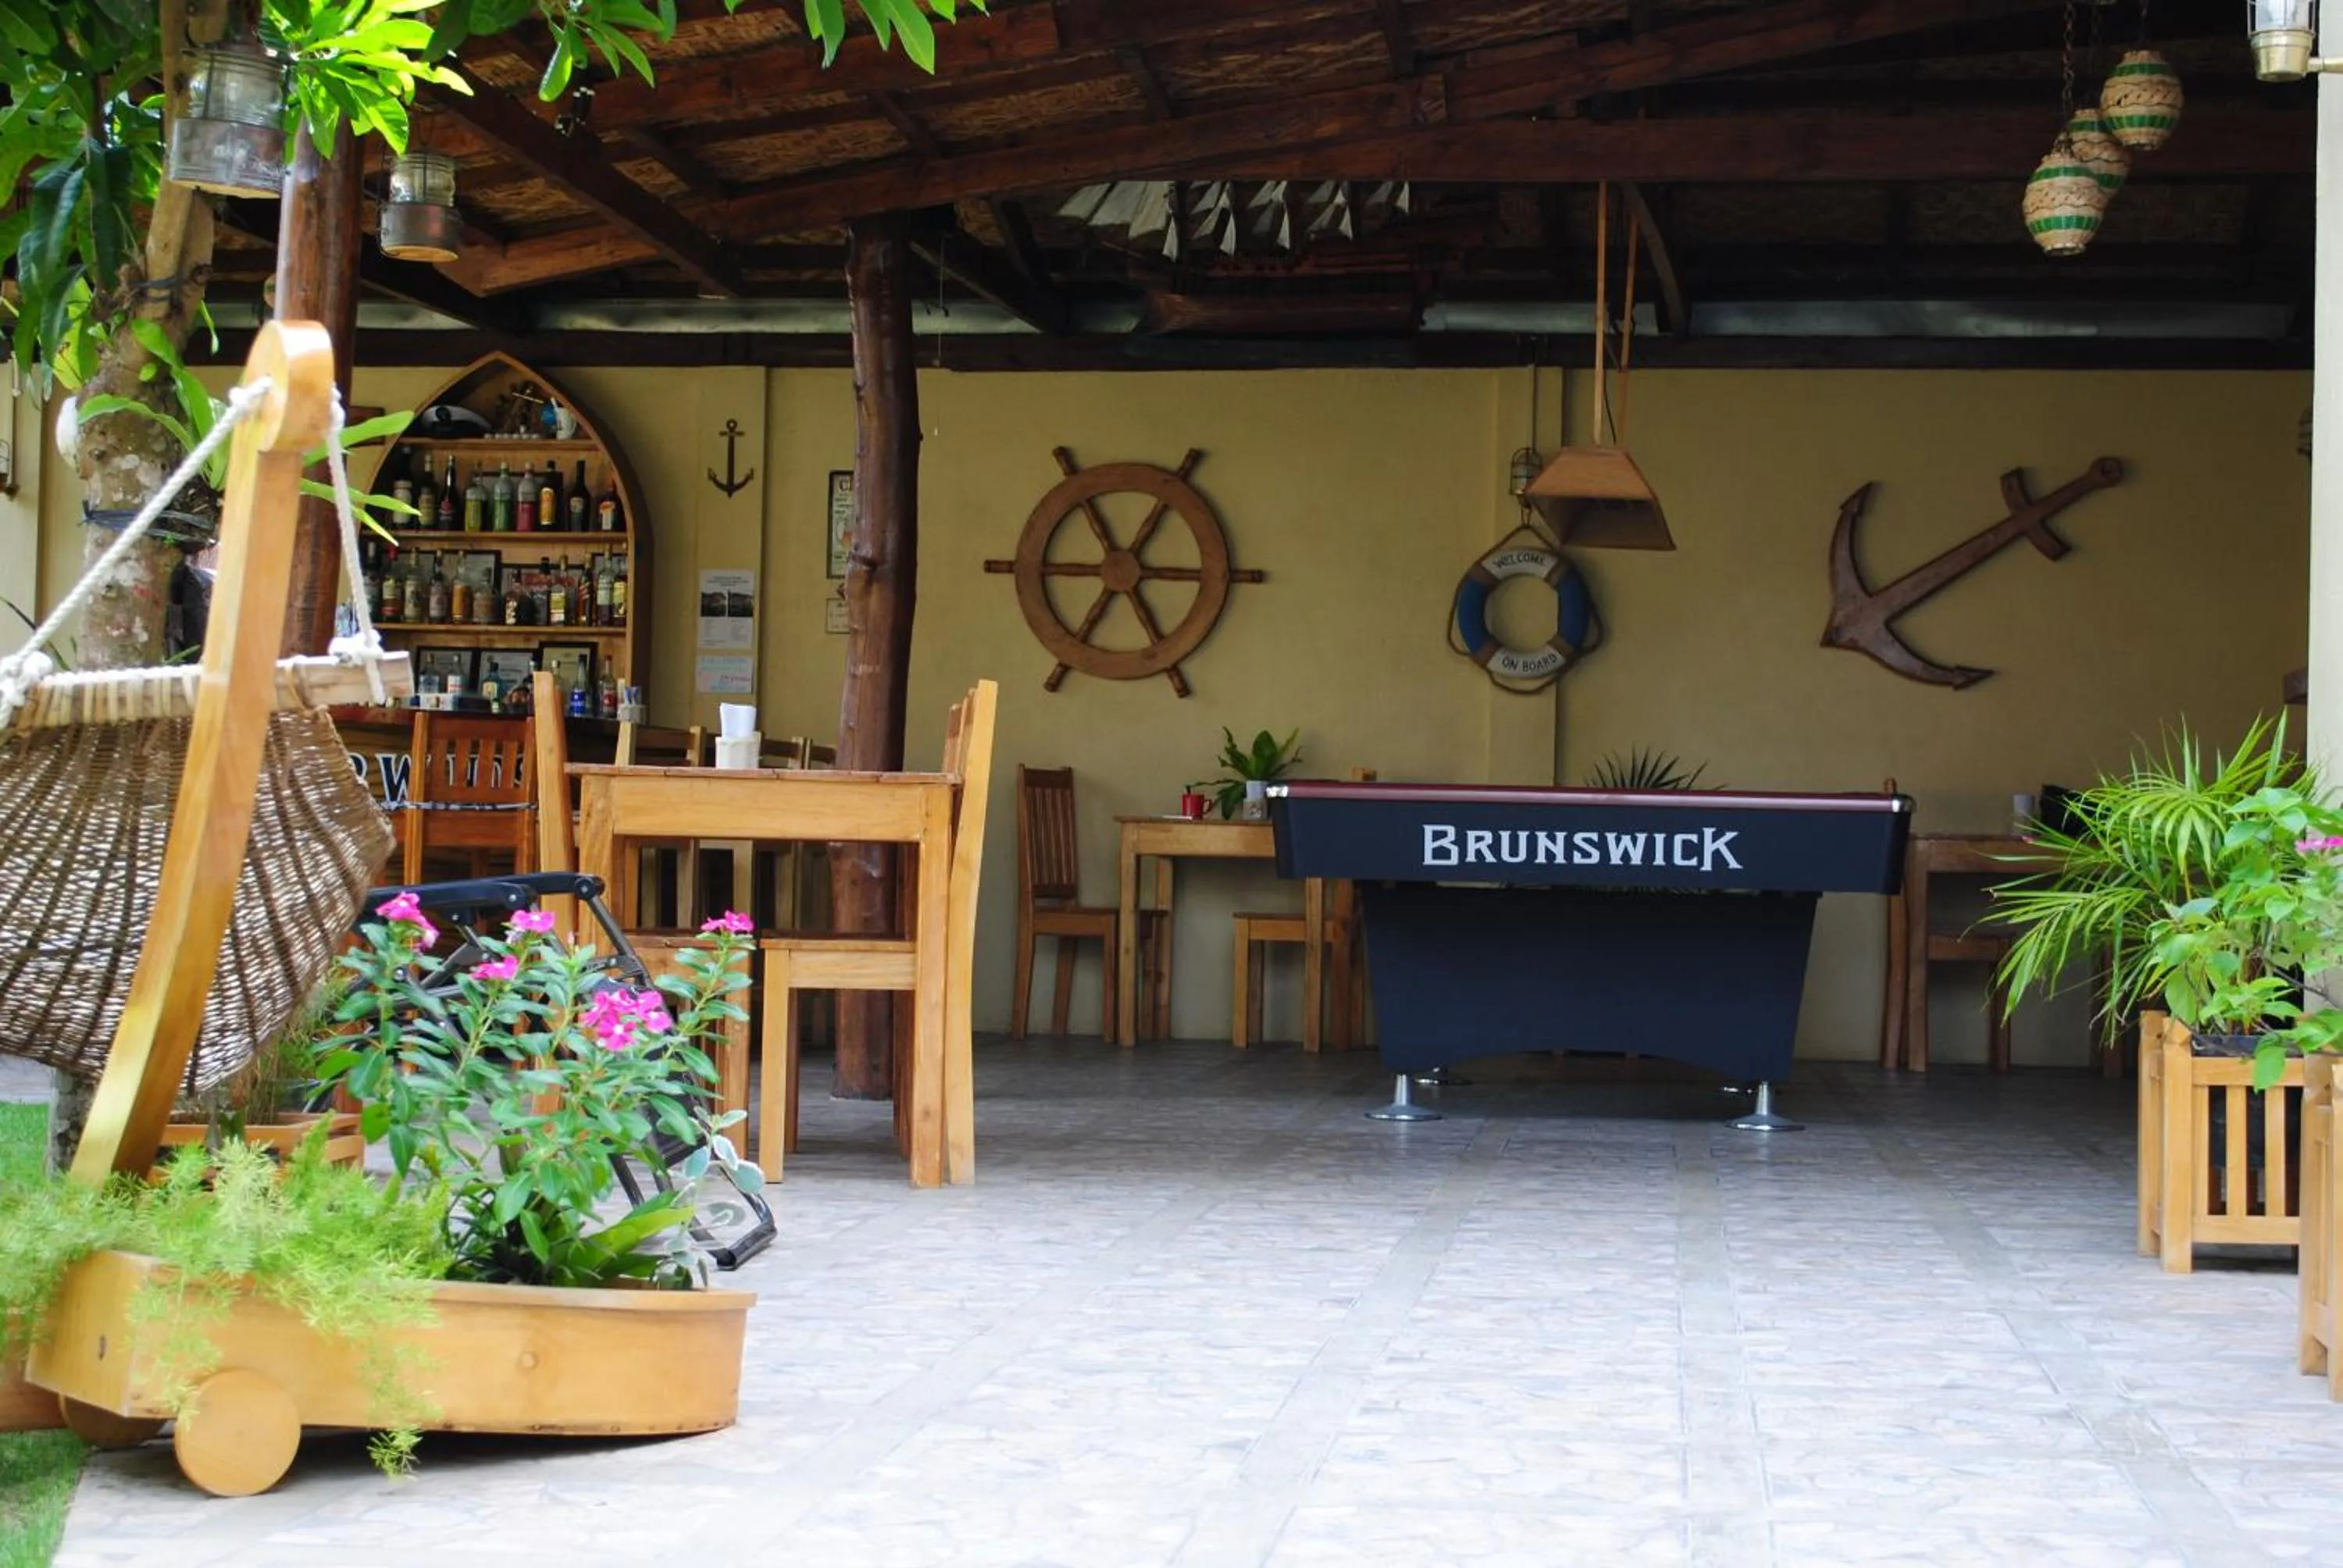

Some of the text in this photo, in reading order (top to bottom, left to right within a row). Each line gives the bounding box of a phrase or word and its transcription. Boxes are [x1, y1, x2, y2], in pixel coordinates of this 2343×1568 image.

[1501, 653, 1557, 672] ON BOARD
[1422, 824, 1743, 871] BRUNSWICK
